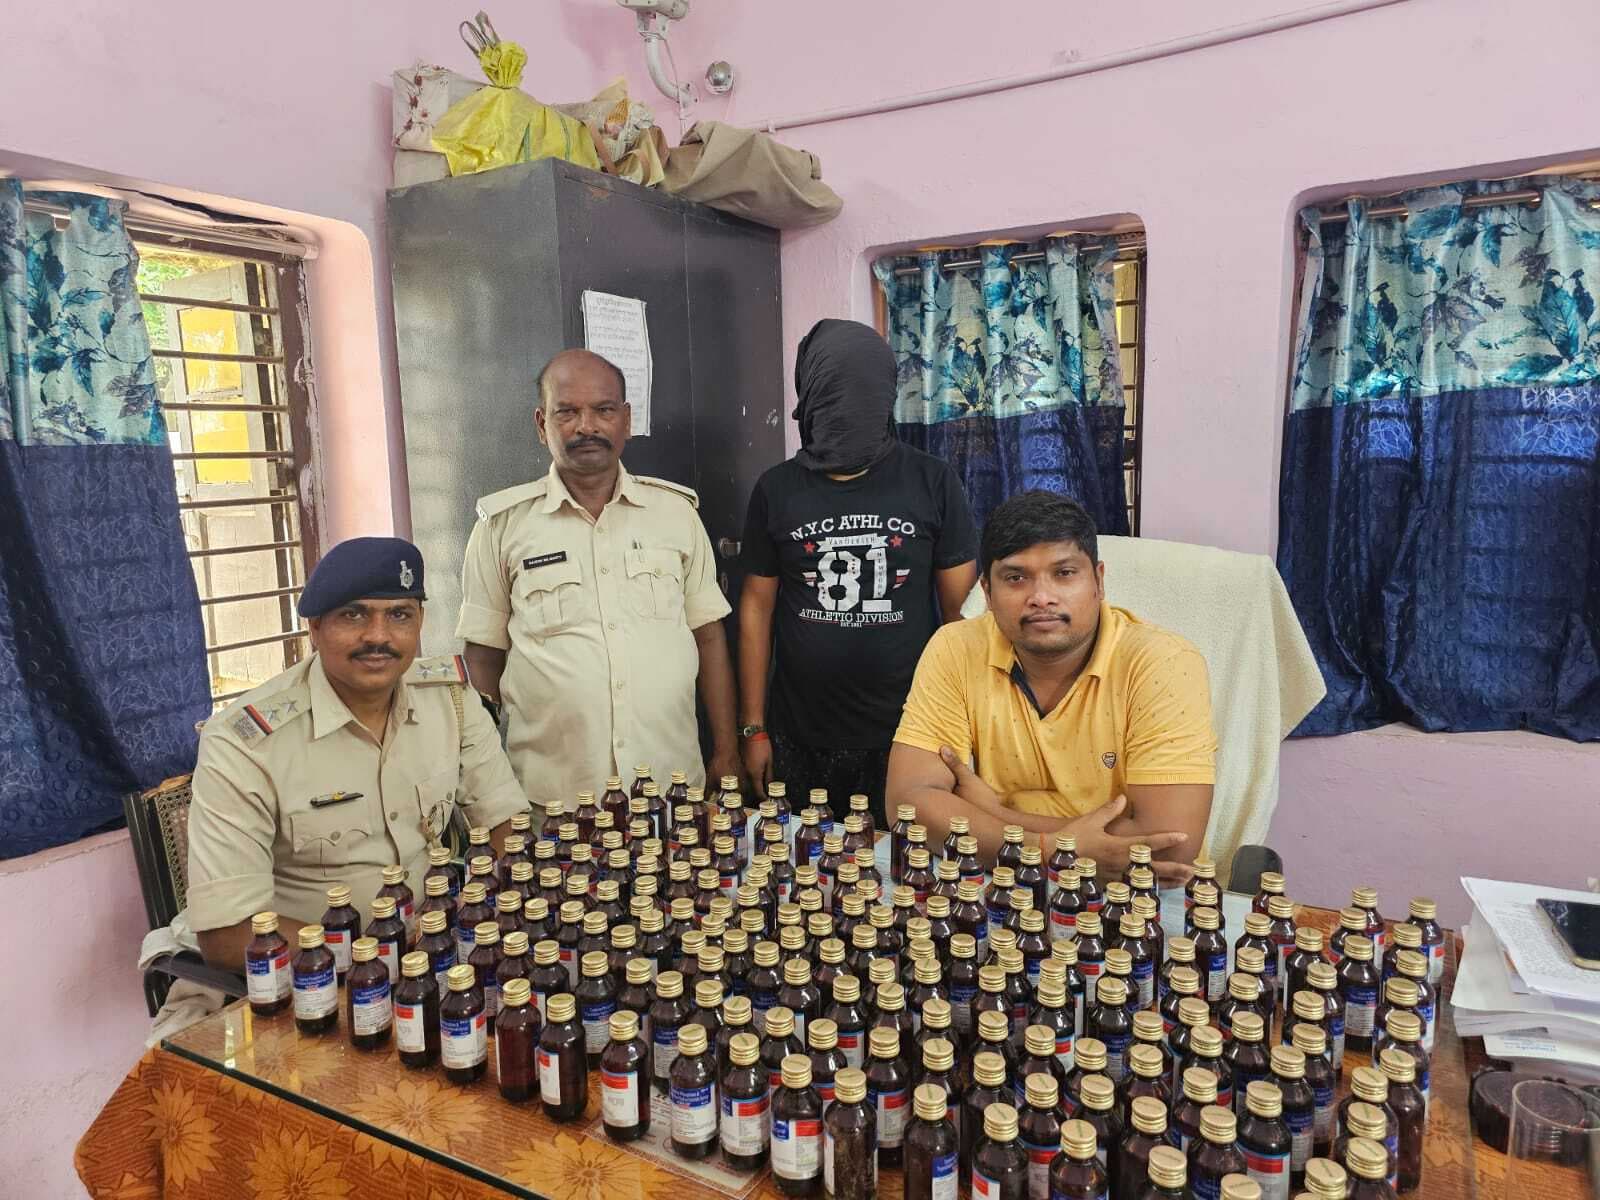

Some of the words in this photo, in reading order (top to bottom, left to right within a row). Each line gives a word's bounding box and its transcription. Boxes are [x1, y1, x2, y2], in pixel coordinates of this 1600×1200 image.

[790, 518, 835, 541] N.Y.C
[838, 515, 883, 530] ATHL
[817, 548, 892, 612] 81
[798, 608, 853, 623] ATHLETIC
[856, 610, 904, 623] DIVISION
